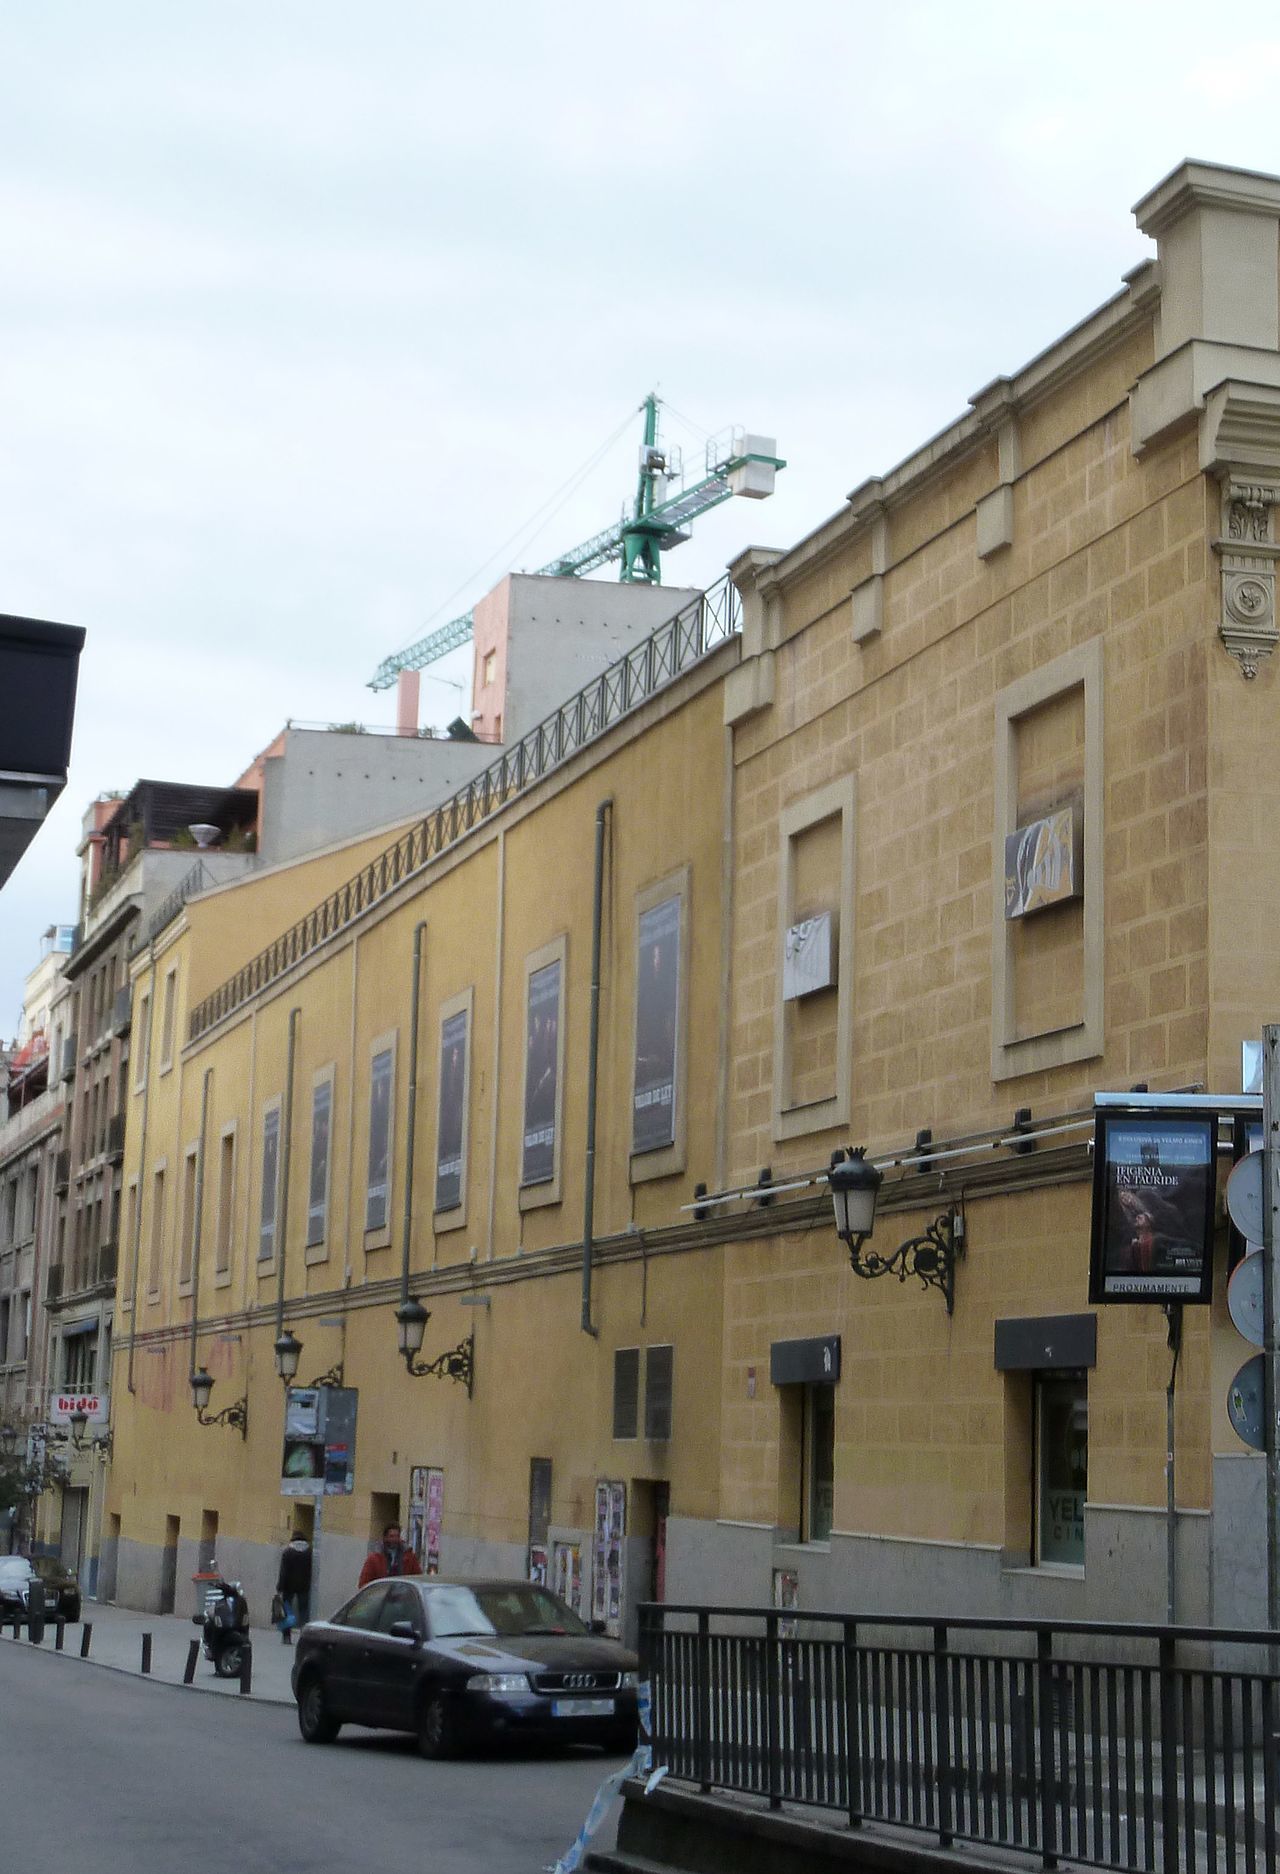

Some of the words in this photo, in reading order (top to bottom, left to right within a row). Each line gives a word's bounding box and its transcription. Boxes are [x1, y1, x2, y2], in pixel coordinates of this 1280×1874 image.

[1116, 1165, 1163, 1177] IFIGENIA
[1116, 1174, 1132, 1185] EN
[1133, 1175, 1180, 1186] TAURIDE
